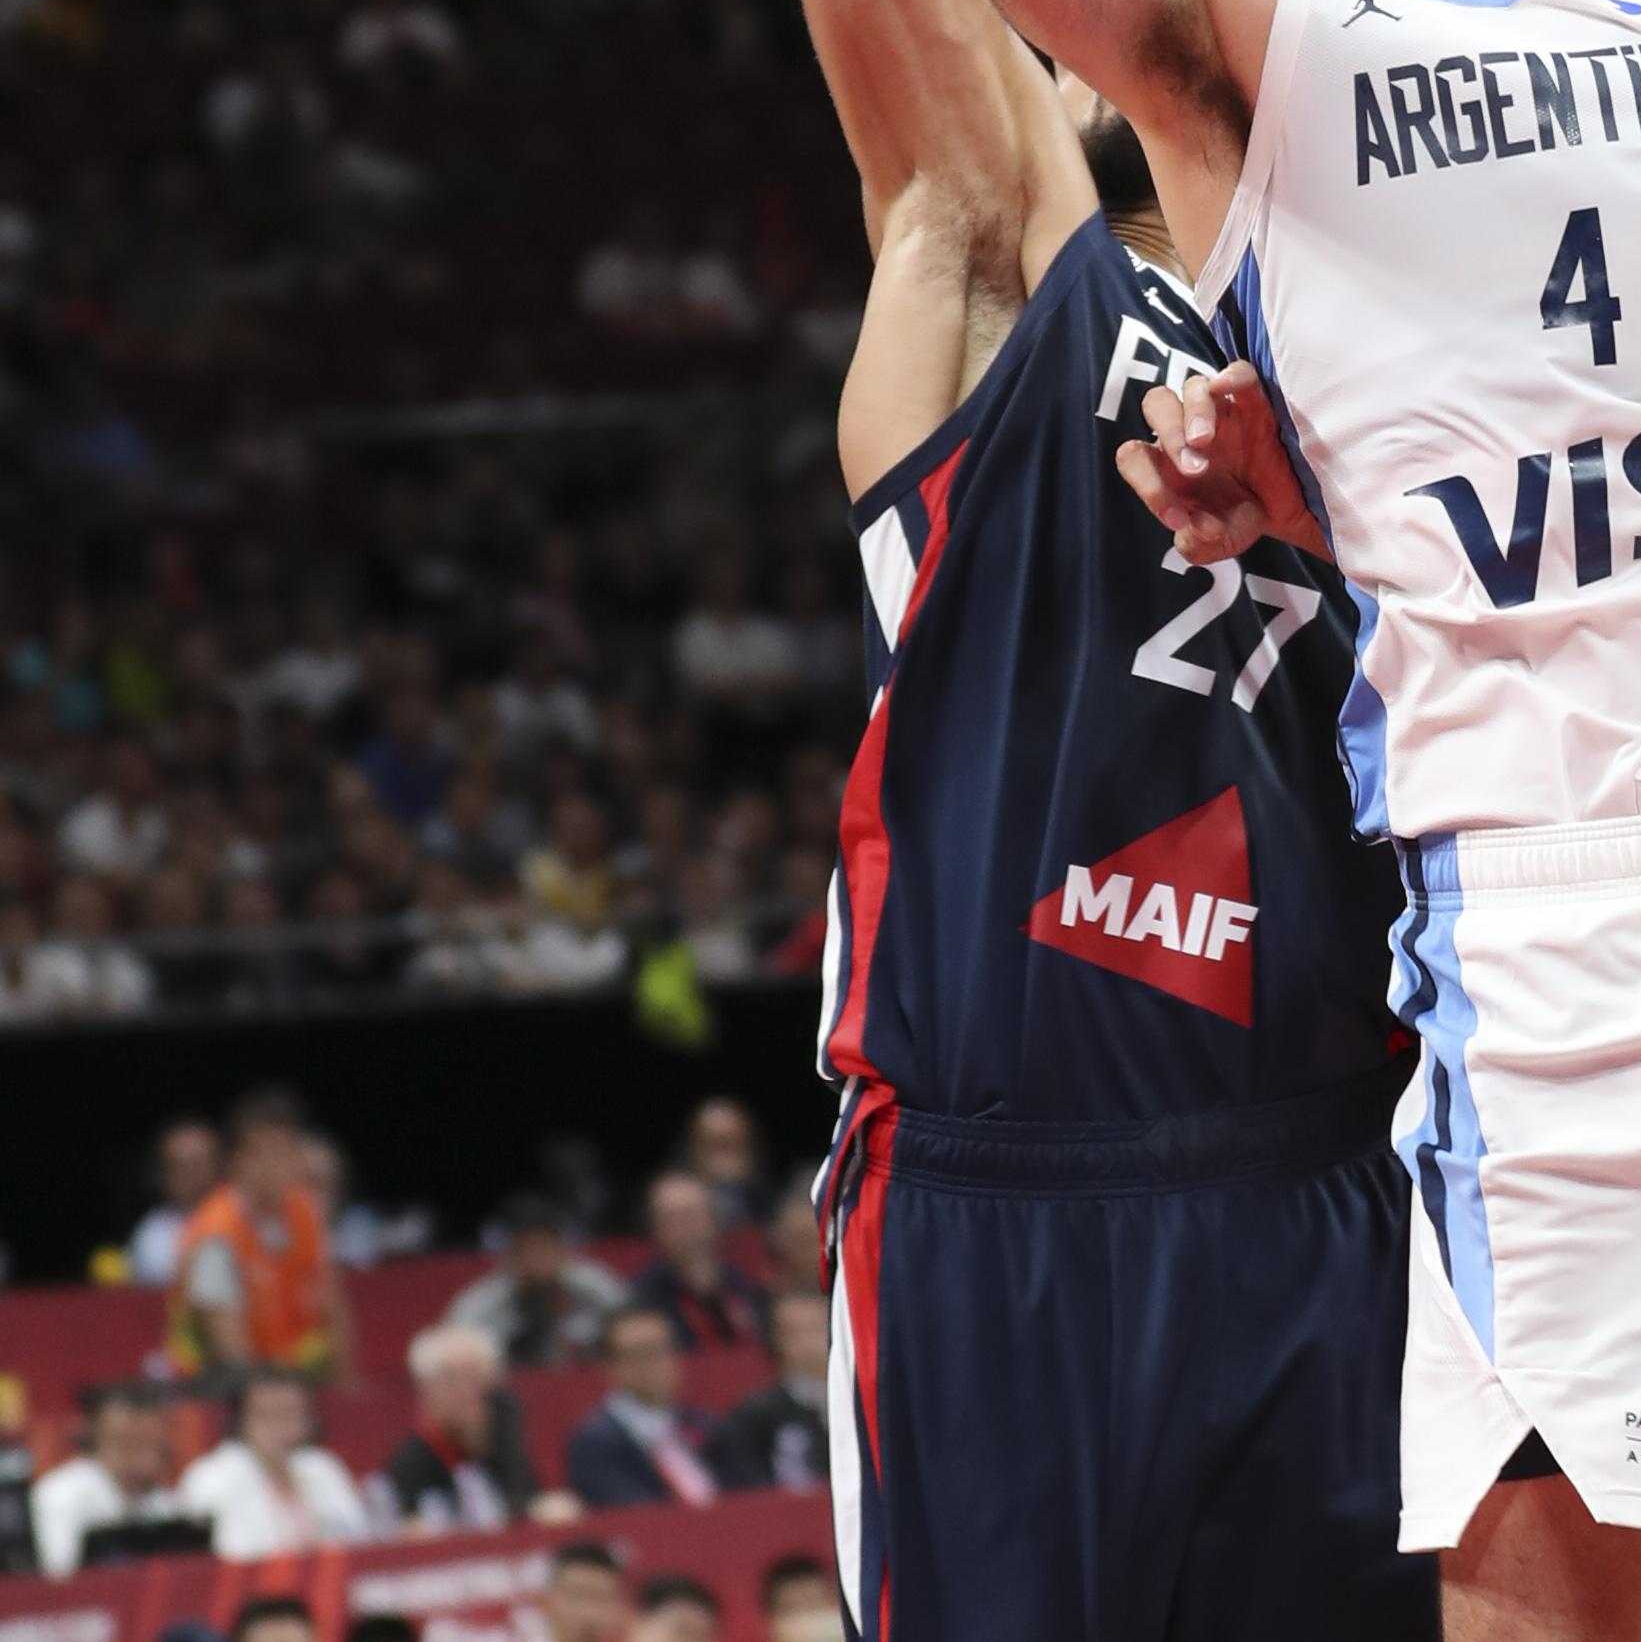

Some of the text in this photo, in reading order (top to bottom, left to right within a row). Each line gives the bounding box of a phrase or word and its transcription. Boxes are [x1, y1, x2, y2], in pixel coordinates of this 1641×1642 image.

[1539, 206, 1622, 367] 4
[1131, 544, 1321, 714] 27
[1059, 864, 1259, 962] MAIF
